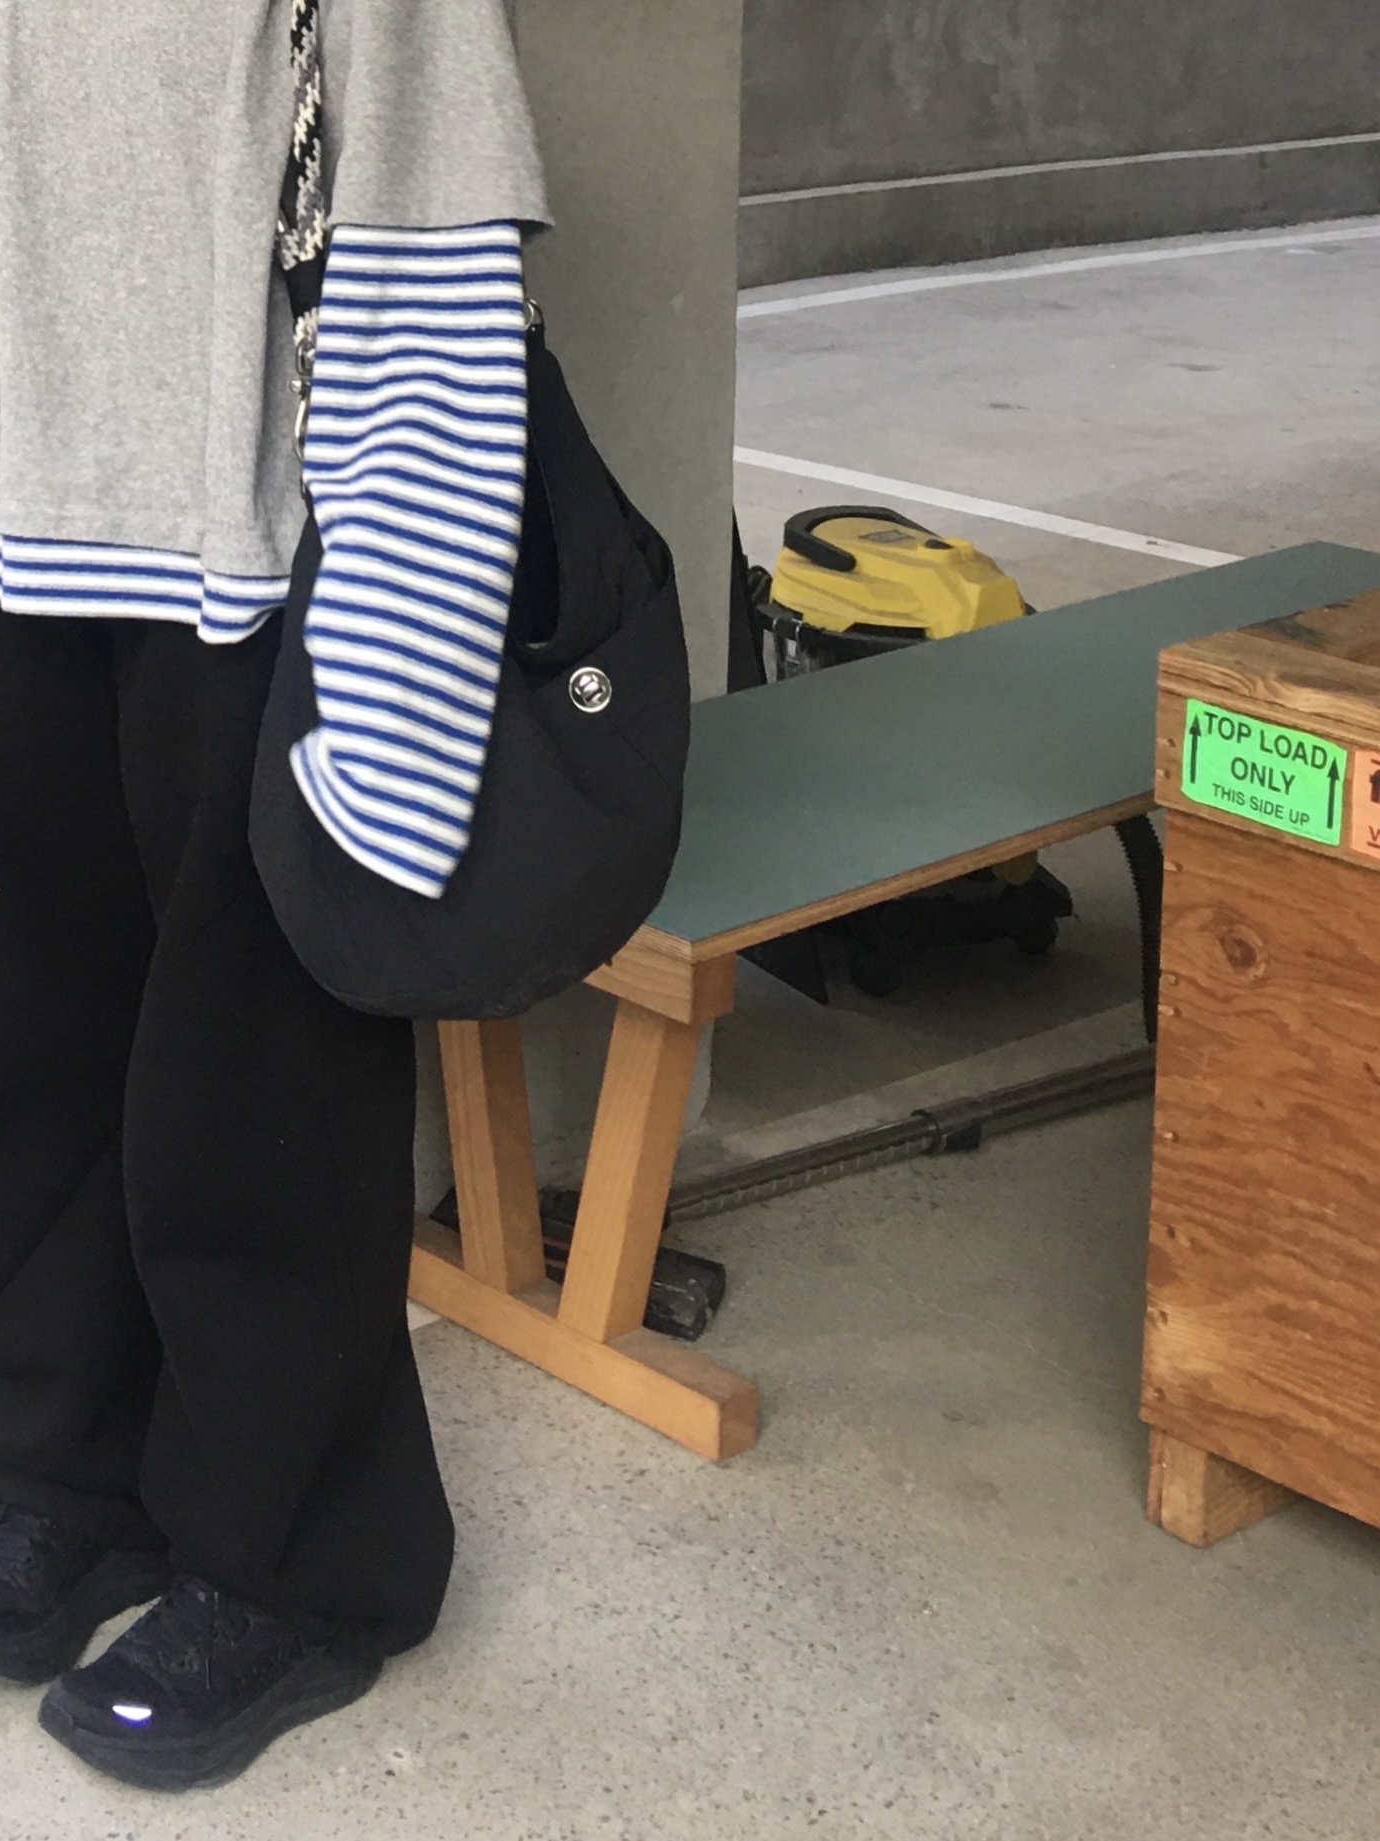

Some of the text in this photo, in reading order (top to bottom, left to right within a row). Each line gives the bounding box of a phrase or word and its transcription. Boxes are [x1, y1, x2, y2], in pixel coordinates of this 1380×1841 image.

[1204, 711, 1328, 770] TOP LOAD
[1231, 757, 1296, 795] ONLY
[1212, 783, 1310, 826] THIS SIDE UP
